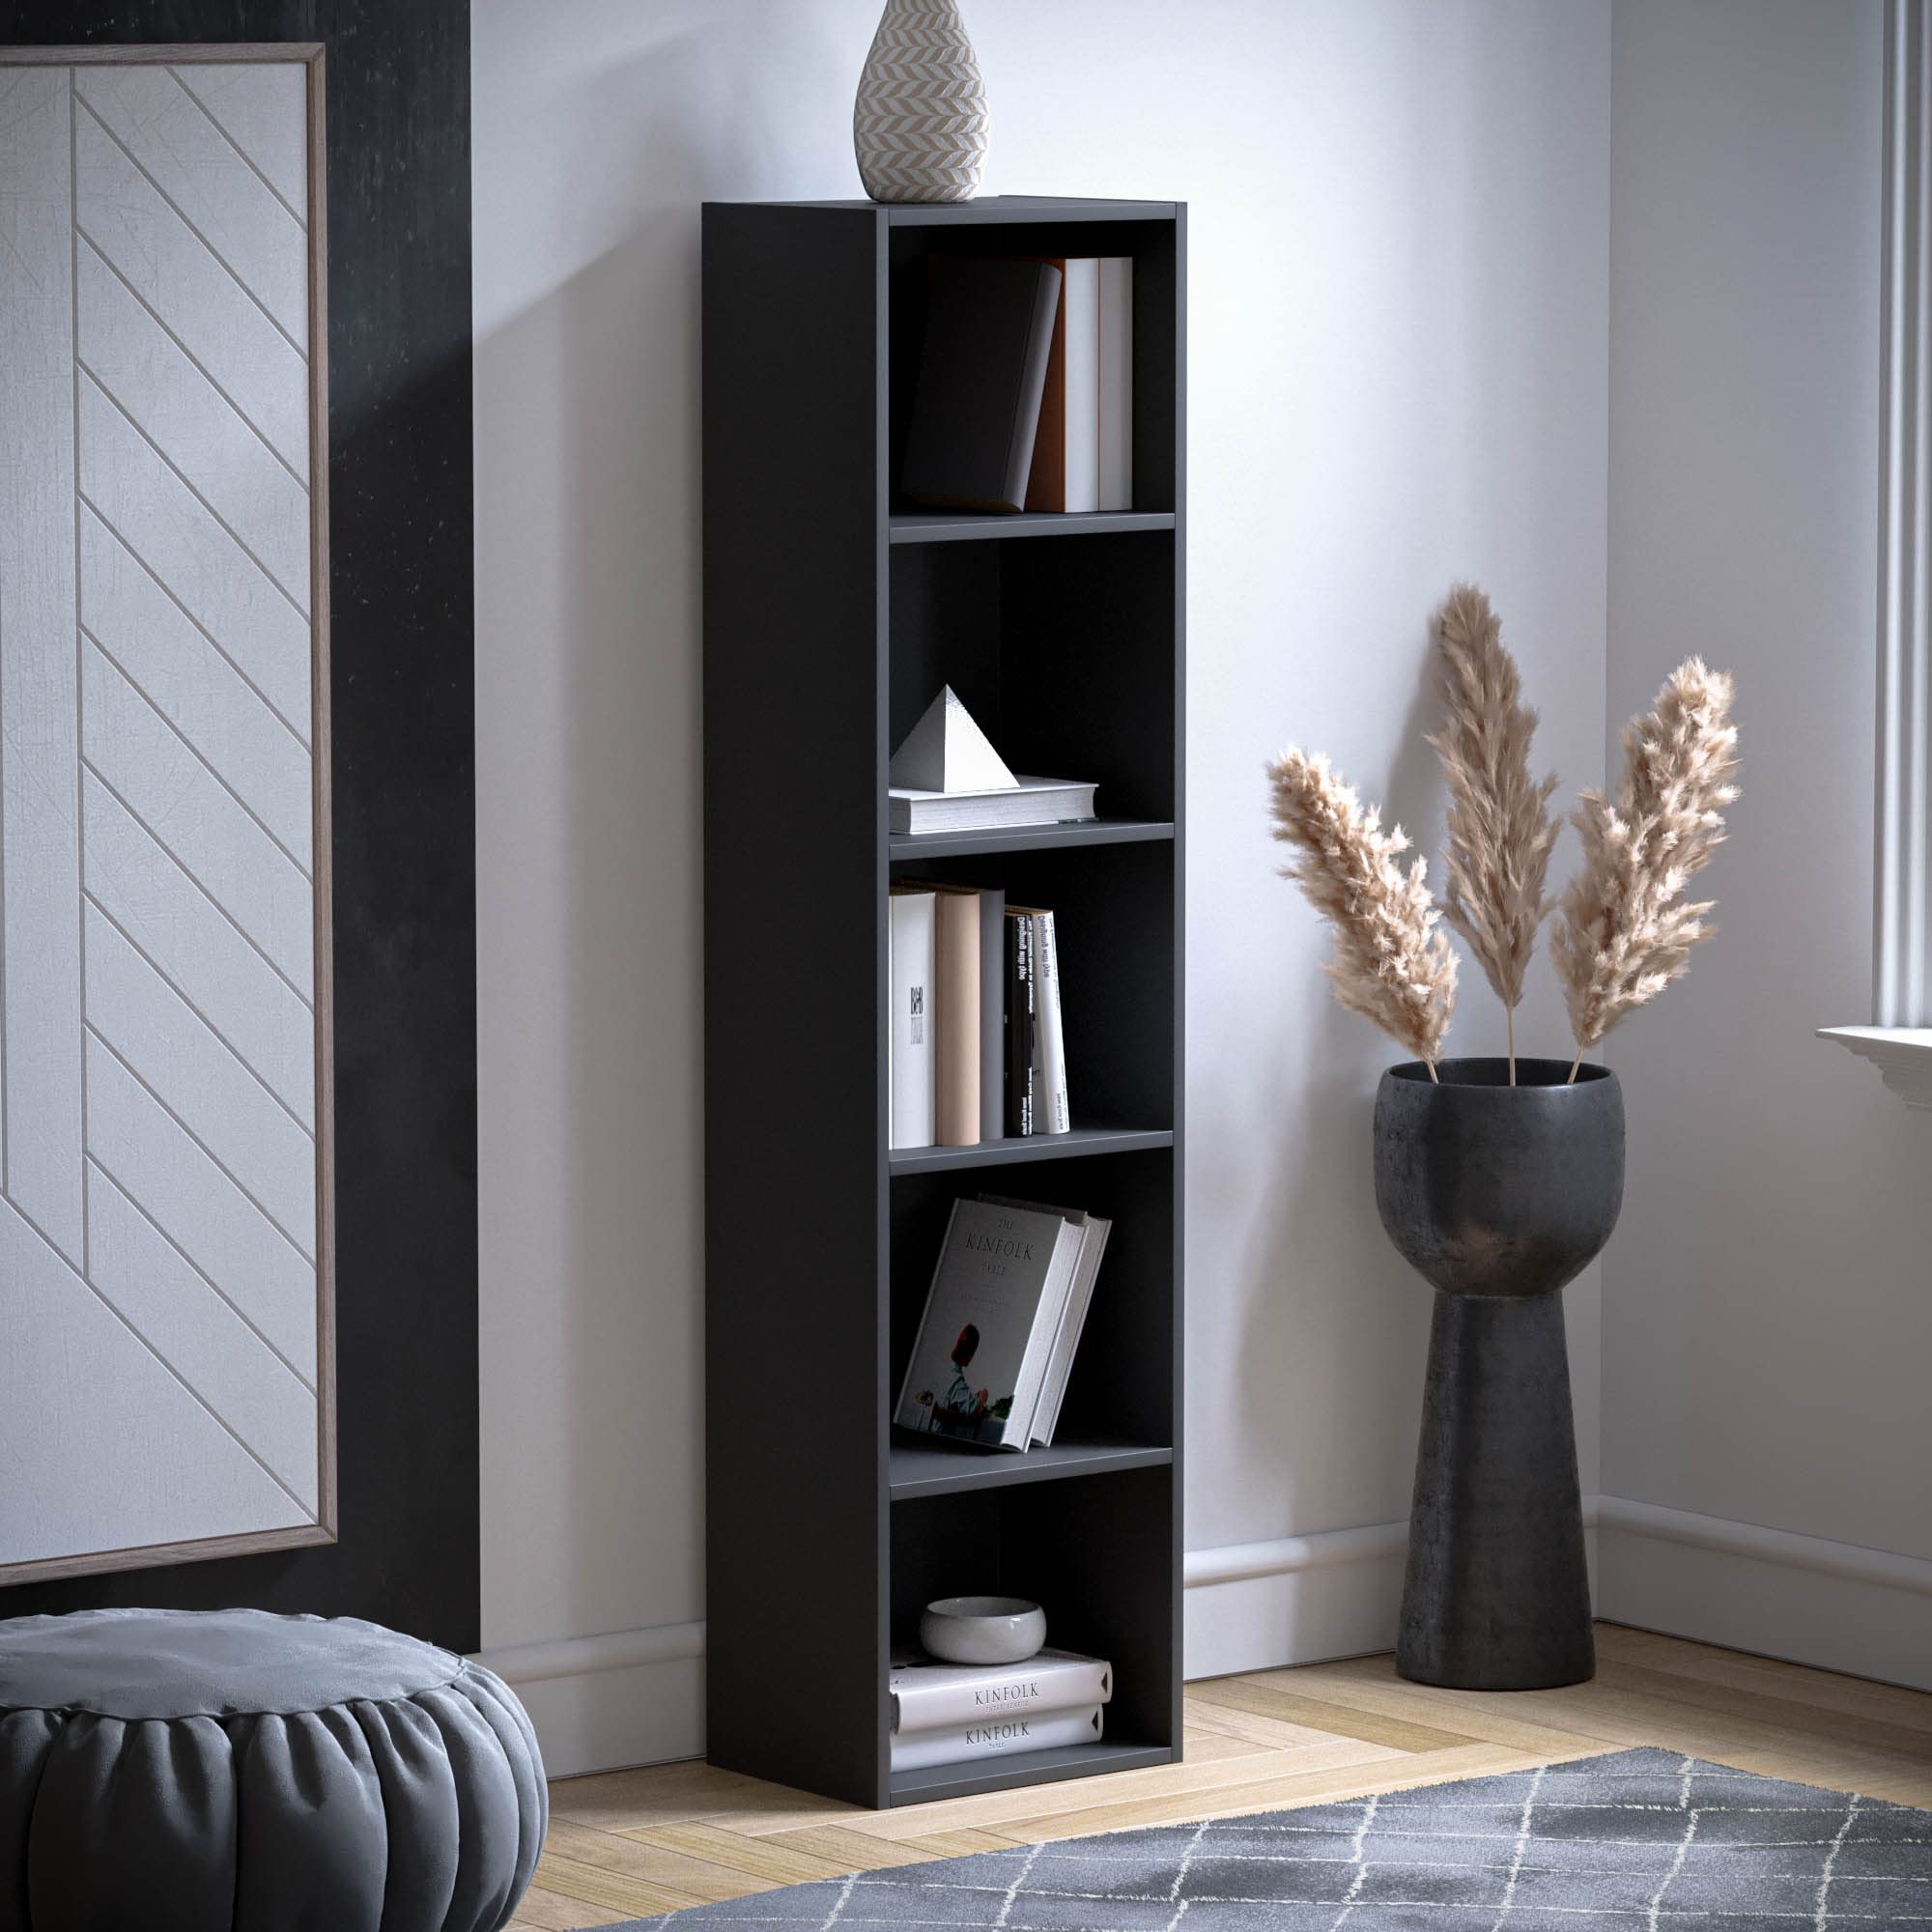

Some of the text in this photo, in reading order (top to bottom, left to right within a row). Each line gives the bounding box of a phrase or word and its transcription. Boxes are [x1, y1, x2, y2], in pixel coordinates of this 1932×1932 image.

[966, 1234, 1035, 1261] KINFOLK
[975, 1683, 1039, 1706] KINFOLK
[966, 1721, 1030, 1745] KINFOLK
